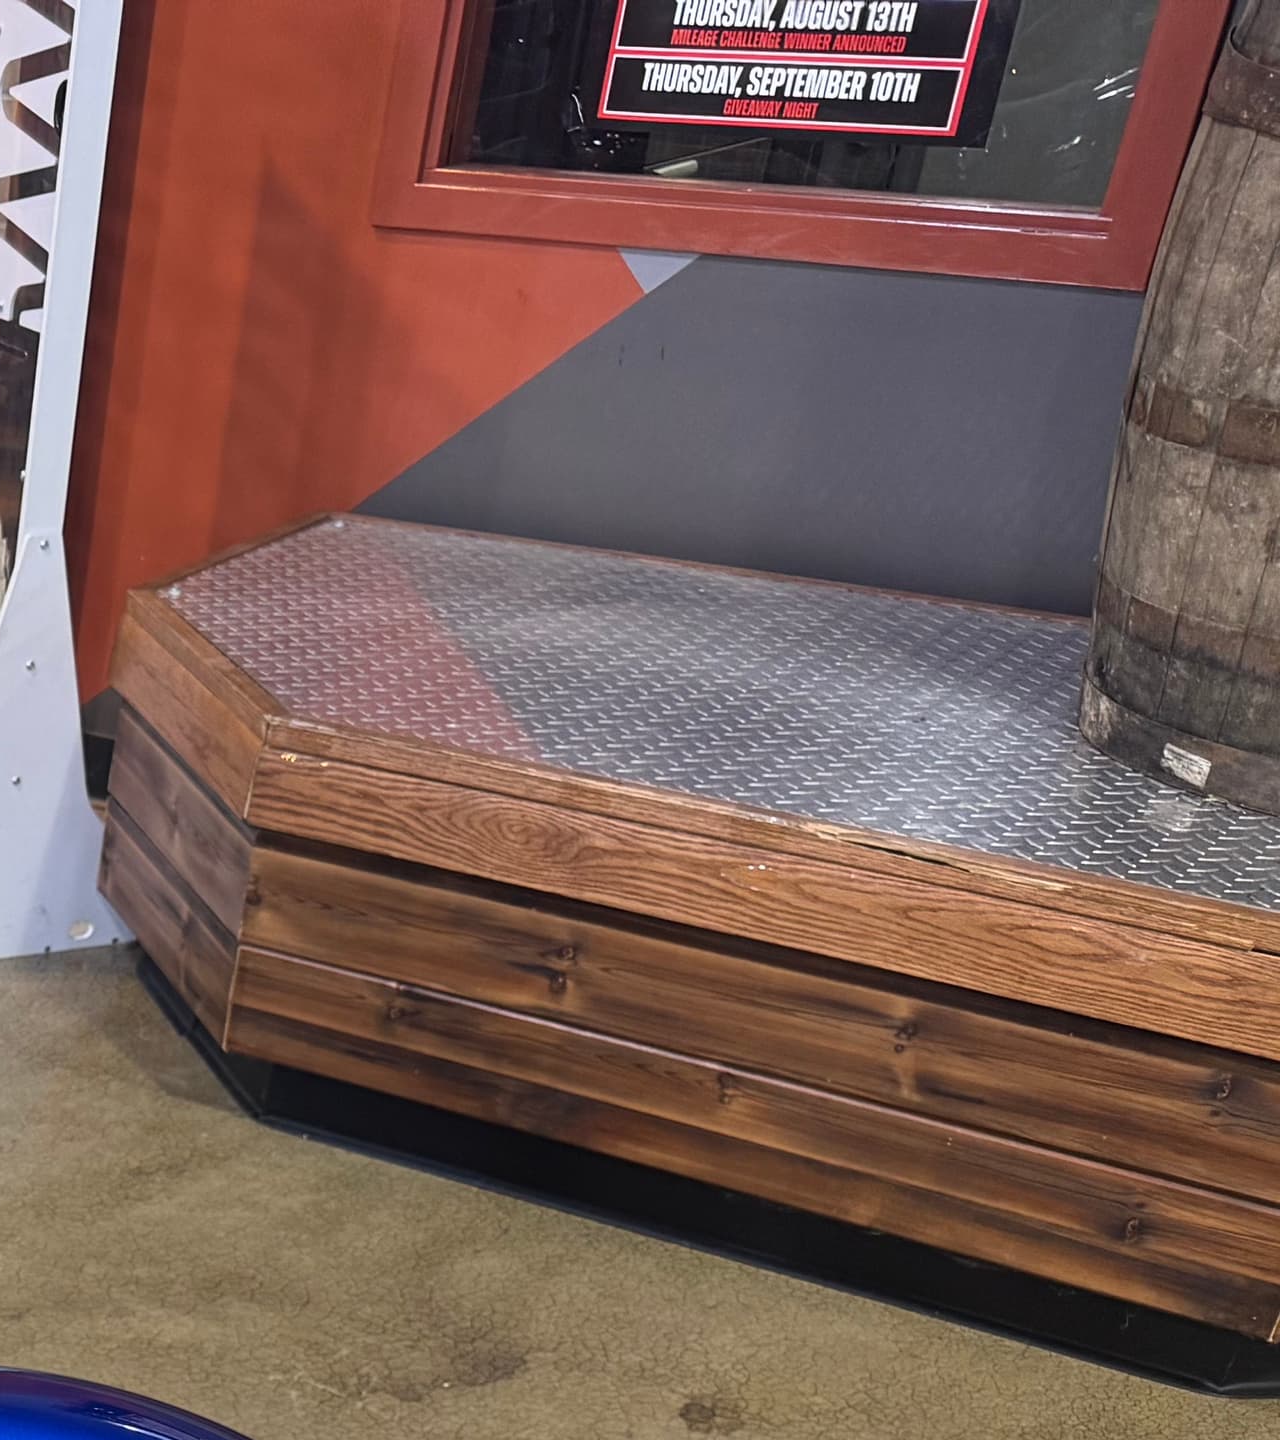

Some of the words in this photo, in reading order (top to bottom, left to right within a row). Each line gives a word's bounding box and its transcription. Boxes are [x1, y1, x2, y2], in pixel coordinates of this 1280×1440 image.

[673, 0, 777, 31] THURSDAY,
[779, 0, 865, 31] AUGUST
[866, 1, 917, 32] 13TH
[670, 29, 718, 46] MILEAGE
[720, 31, 781, 48] CHALLENGE
[784, 33, 831, 50] WINNER
[832, 34, 907, 53] ANNOUNCED
[642, 62, 743, 98] THURSDAY,
[746, 66, 867, 101] SEPTEMBER
[869, 71, 921, 102] 10TH
[723, 99, 782, 117] GIVEAWAY
[782, 102, 819, 119] NIGHT
